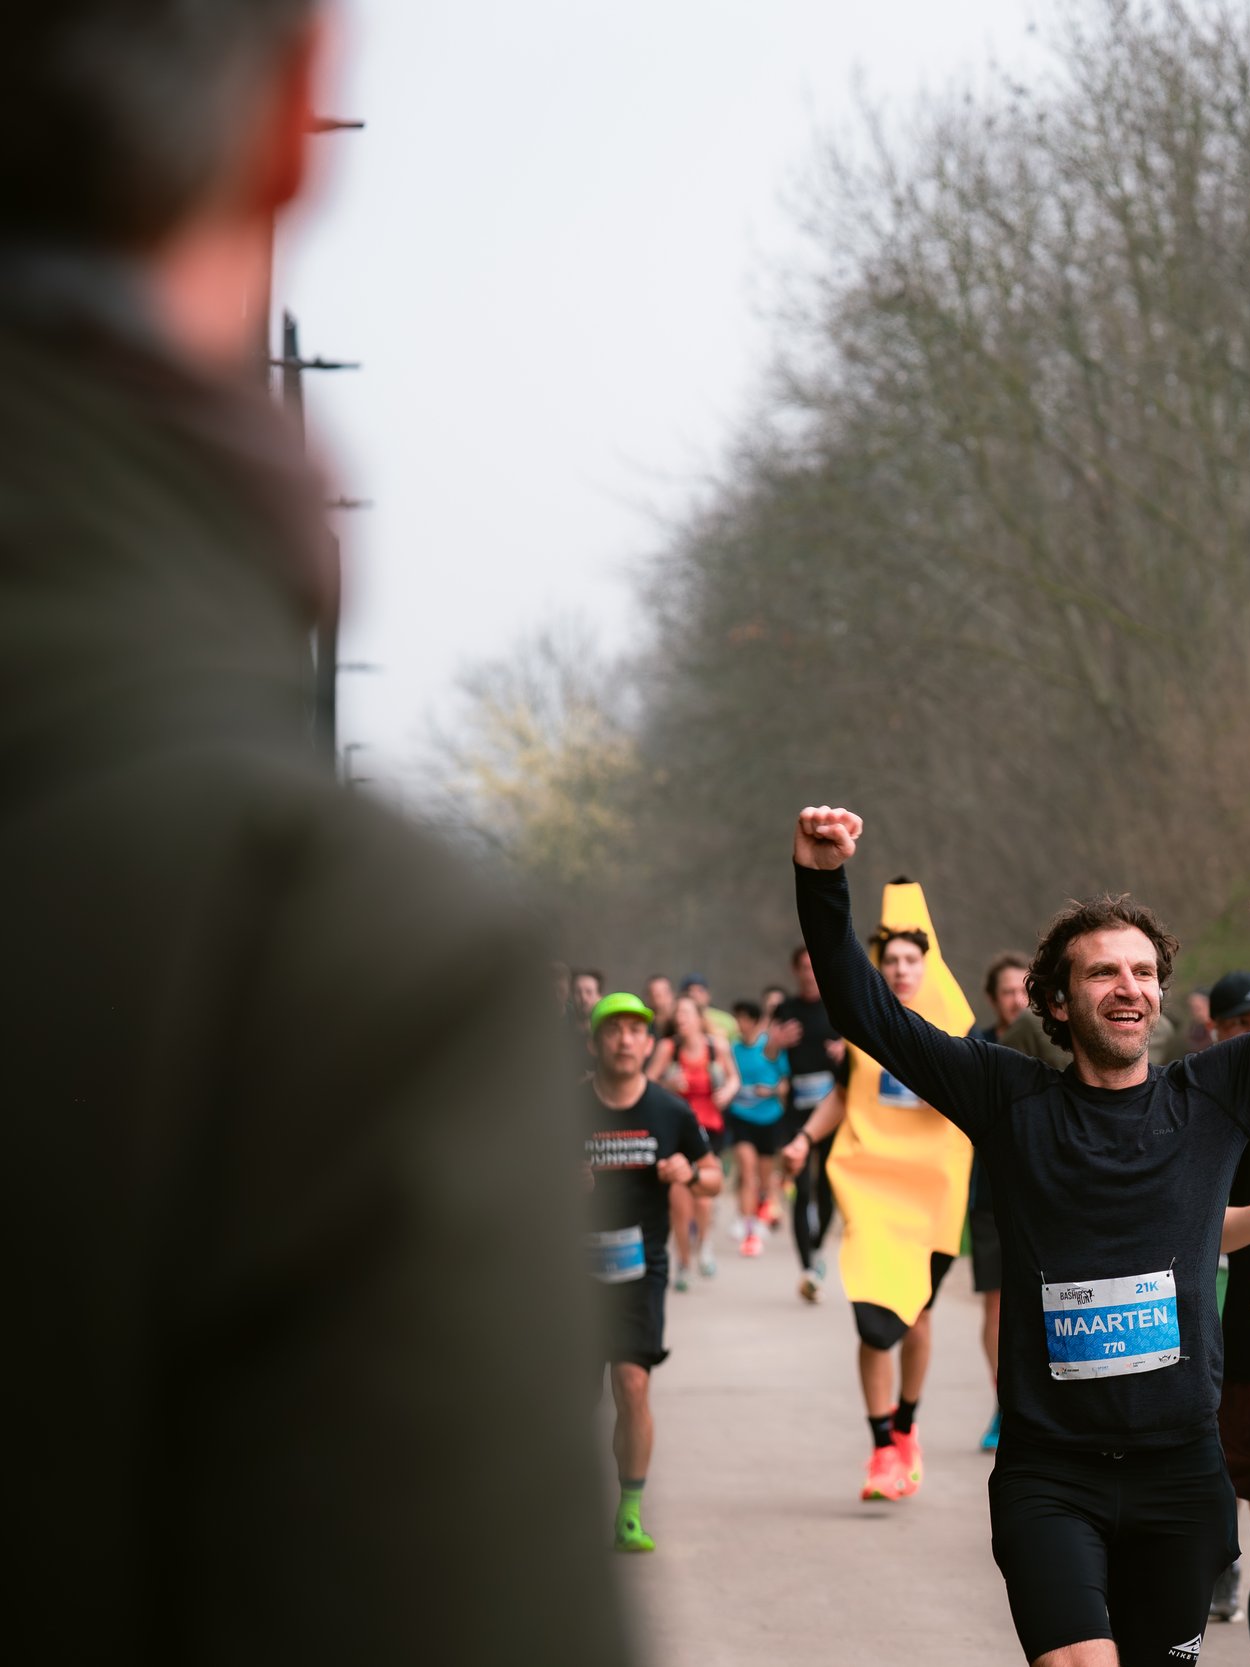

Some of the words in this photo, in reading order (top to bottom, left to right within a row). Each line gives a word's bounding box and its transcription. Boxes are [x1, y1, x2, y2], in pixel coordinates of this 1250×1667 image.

[1135, 1280, 1160, 1295] 21K
[1054, 1305, 1169, 1337] MAARTEN
[1103, 1341, 1126, 1354] 770
[1168, 1649, 1192, 1660] NIKE
